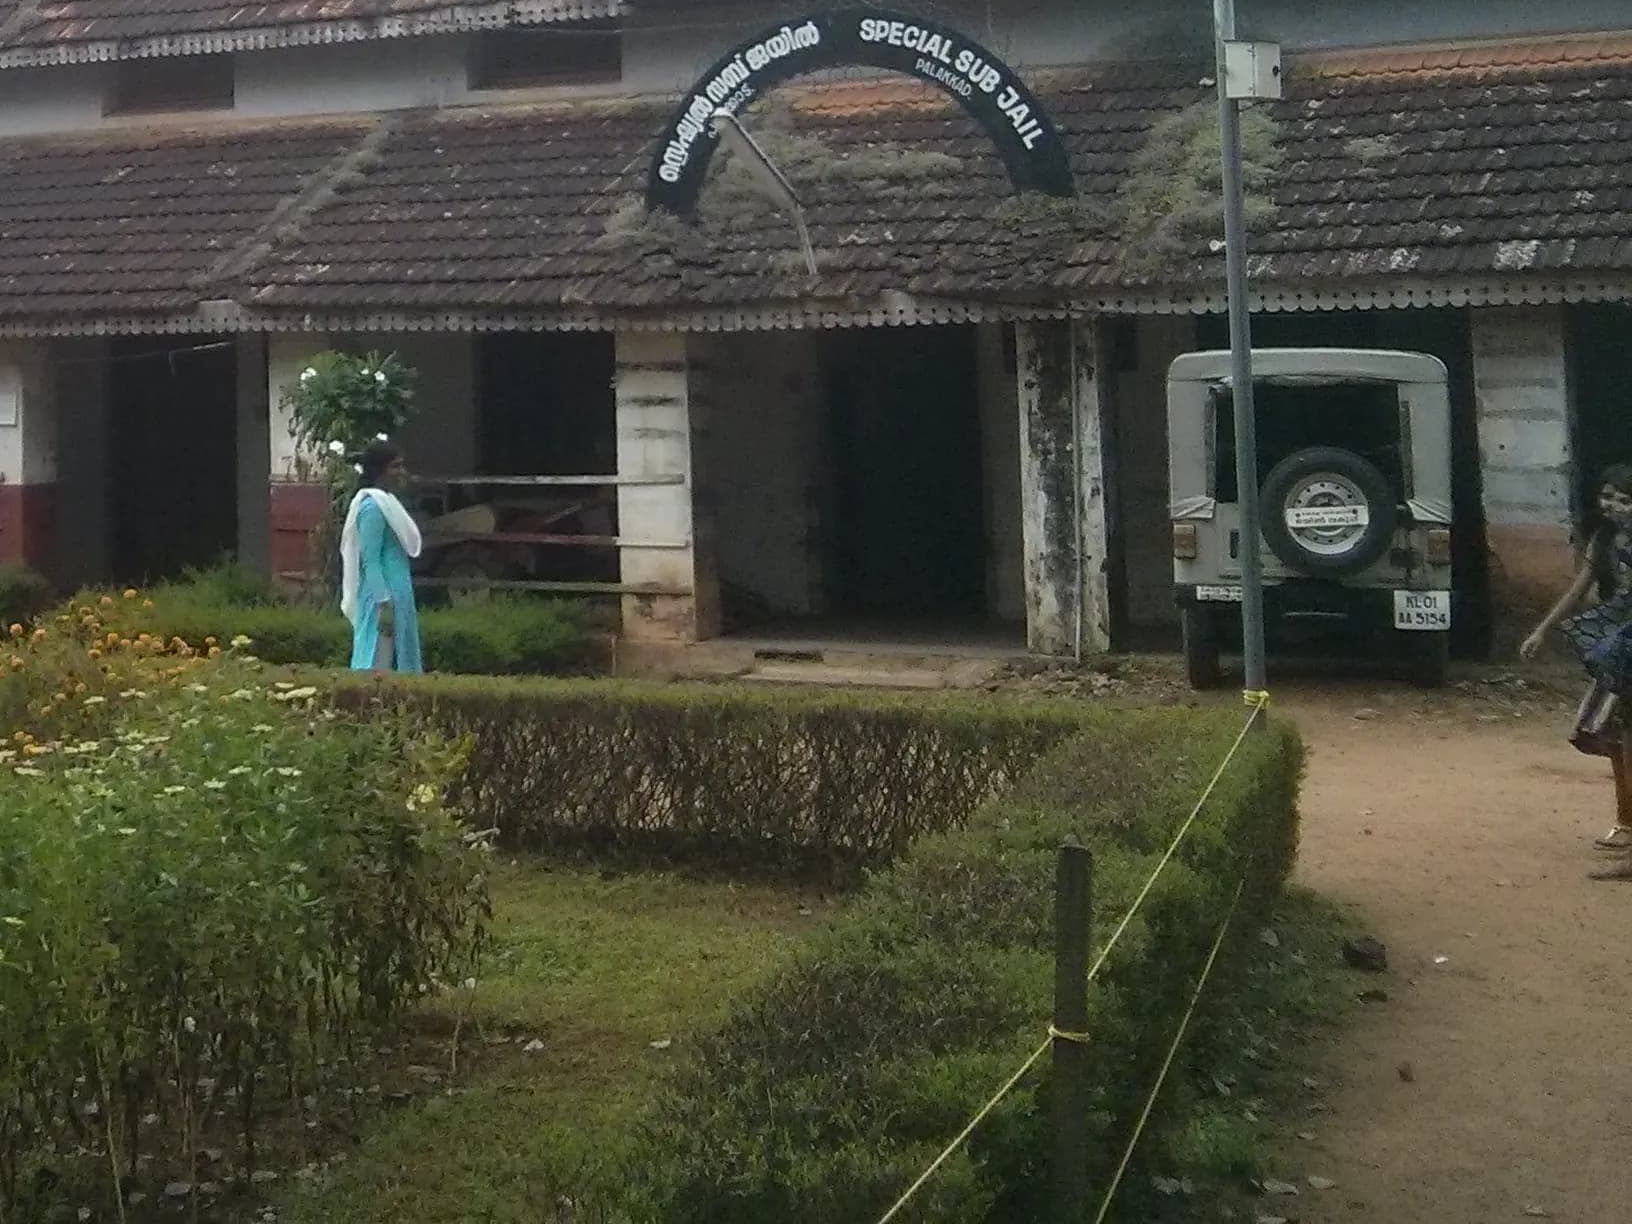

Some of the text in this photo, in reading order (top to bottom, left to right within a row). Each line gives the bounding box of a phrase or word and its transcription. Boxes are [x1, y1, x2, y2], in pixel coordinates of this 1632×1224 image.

[745, 20, 820, 71] ജയിൽ
[859, 18, 1043, 150] SPECIAL SUB JAIL
